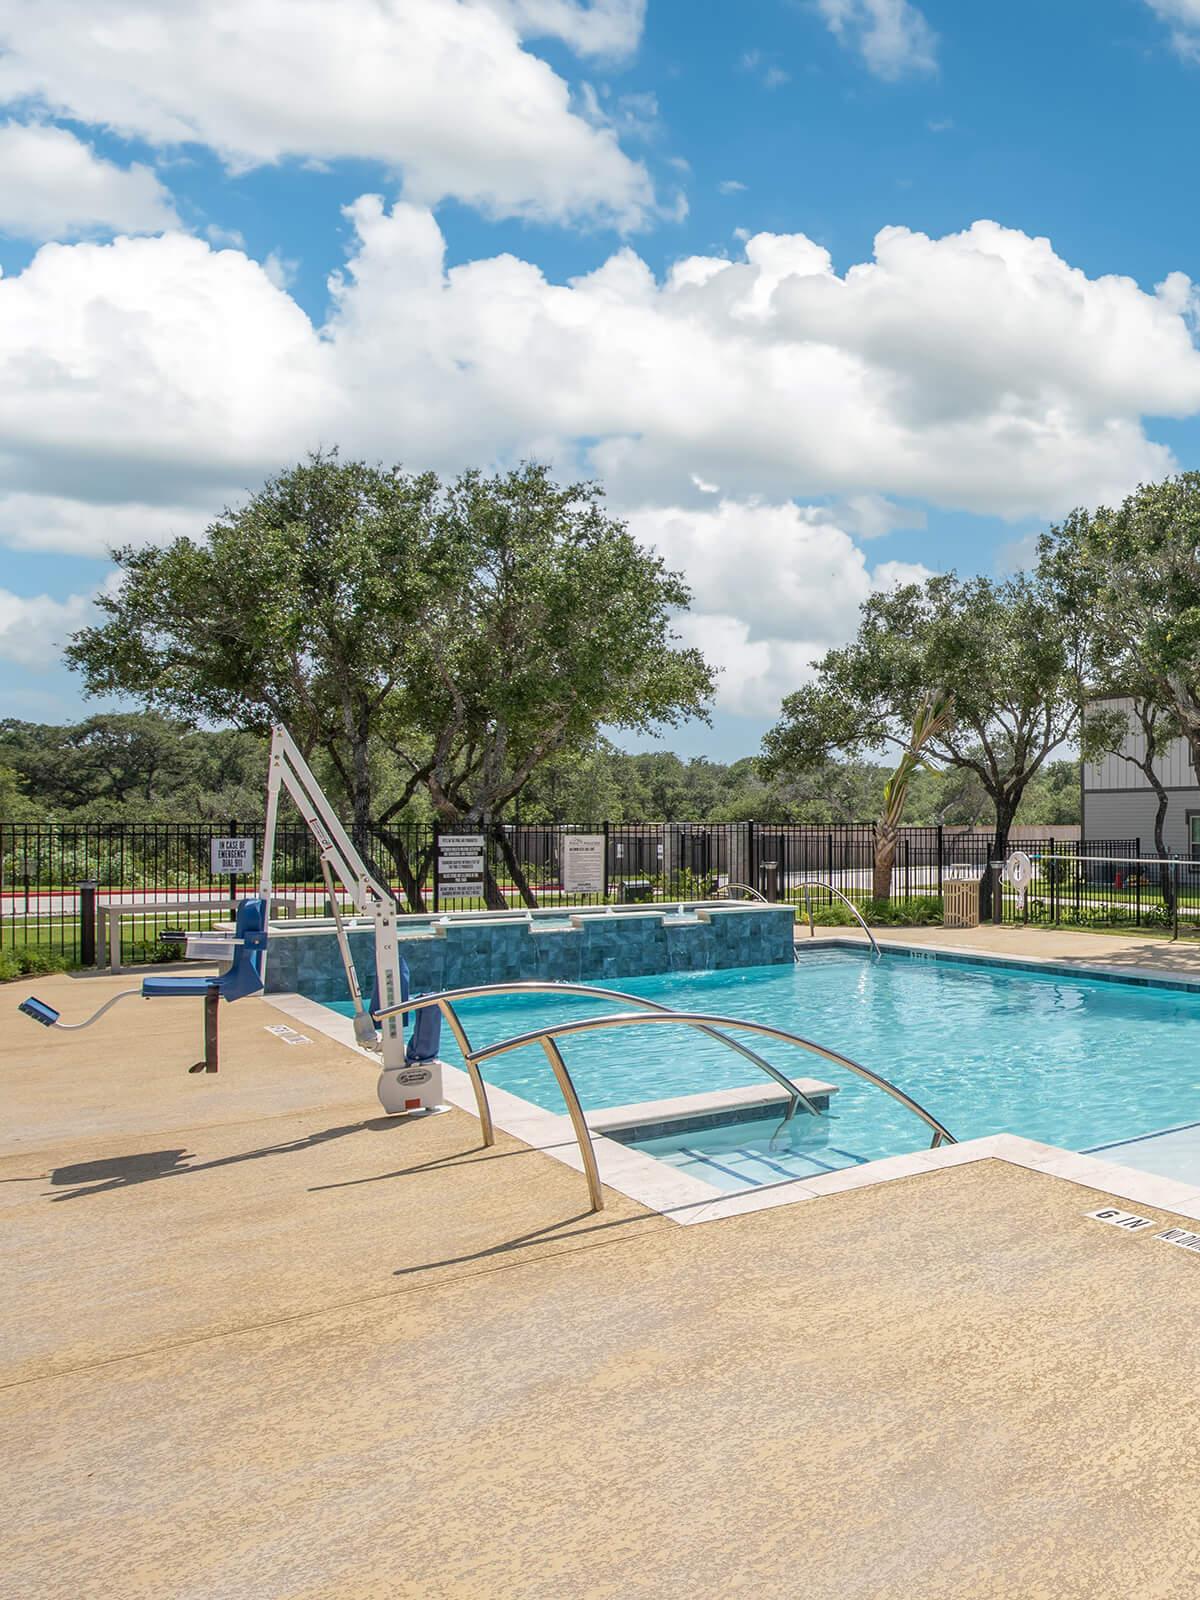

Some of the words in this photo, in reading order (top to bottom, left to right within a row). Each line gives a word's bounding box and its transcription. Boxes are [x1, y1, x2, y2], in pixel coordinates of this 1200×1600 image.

[226, 841, 238, 849] CASE
[239, 841, 245, 849] OF
[218, 850, 247, 858] EMERGENCY
[1095, 1210, 1120, 1219] 6
[1115, 1216, 1150, 1229] IN
[1160, 1229, 1185, 1240] NO
